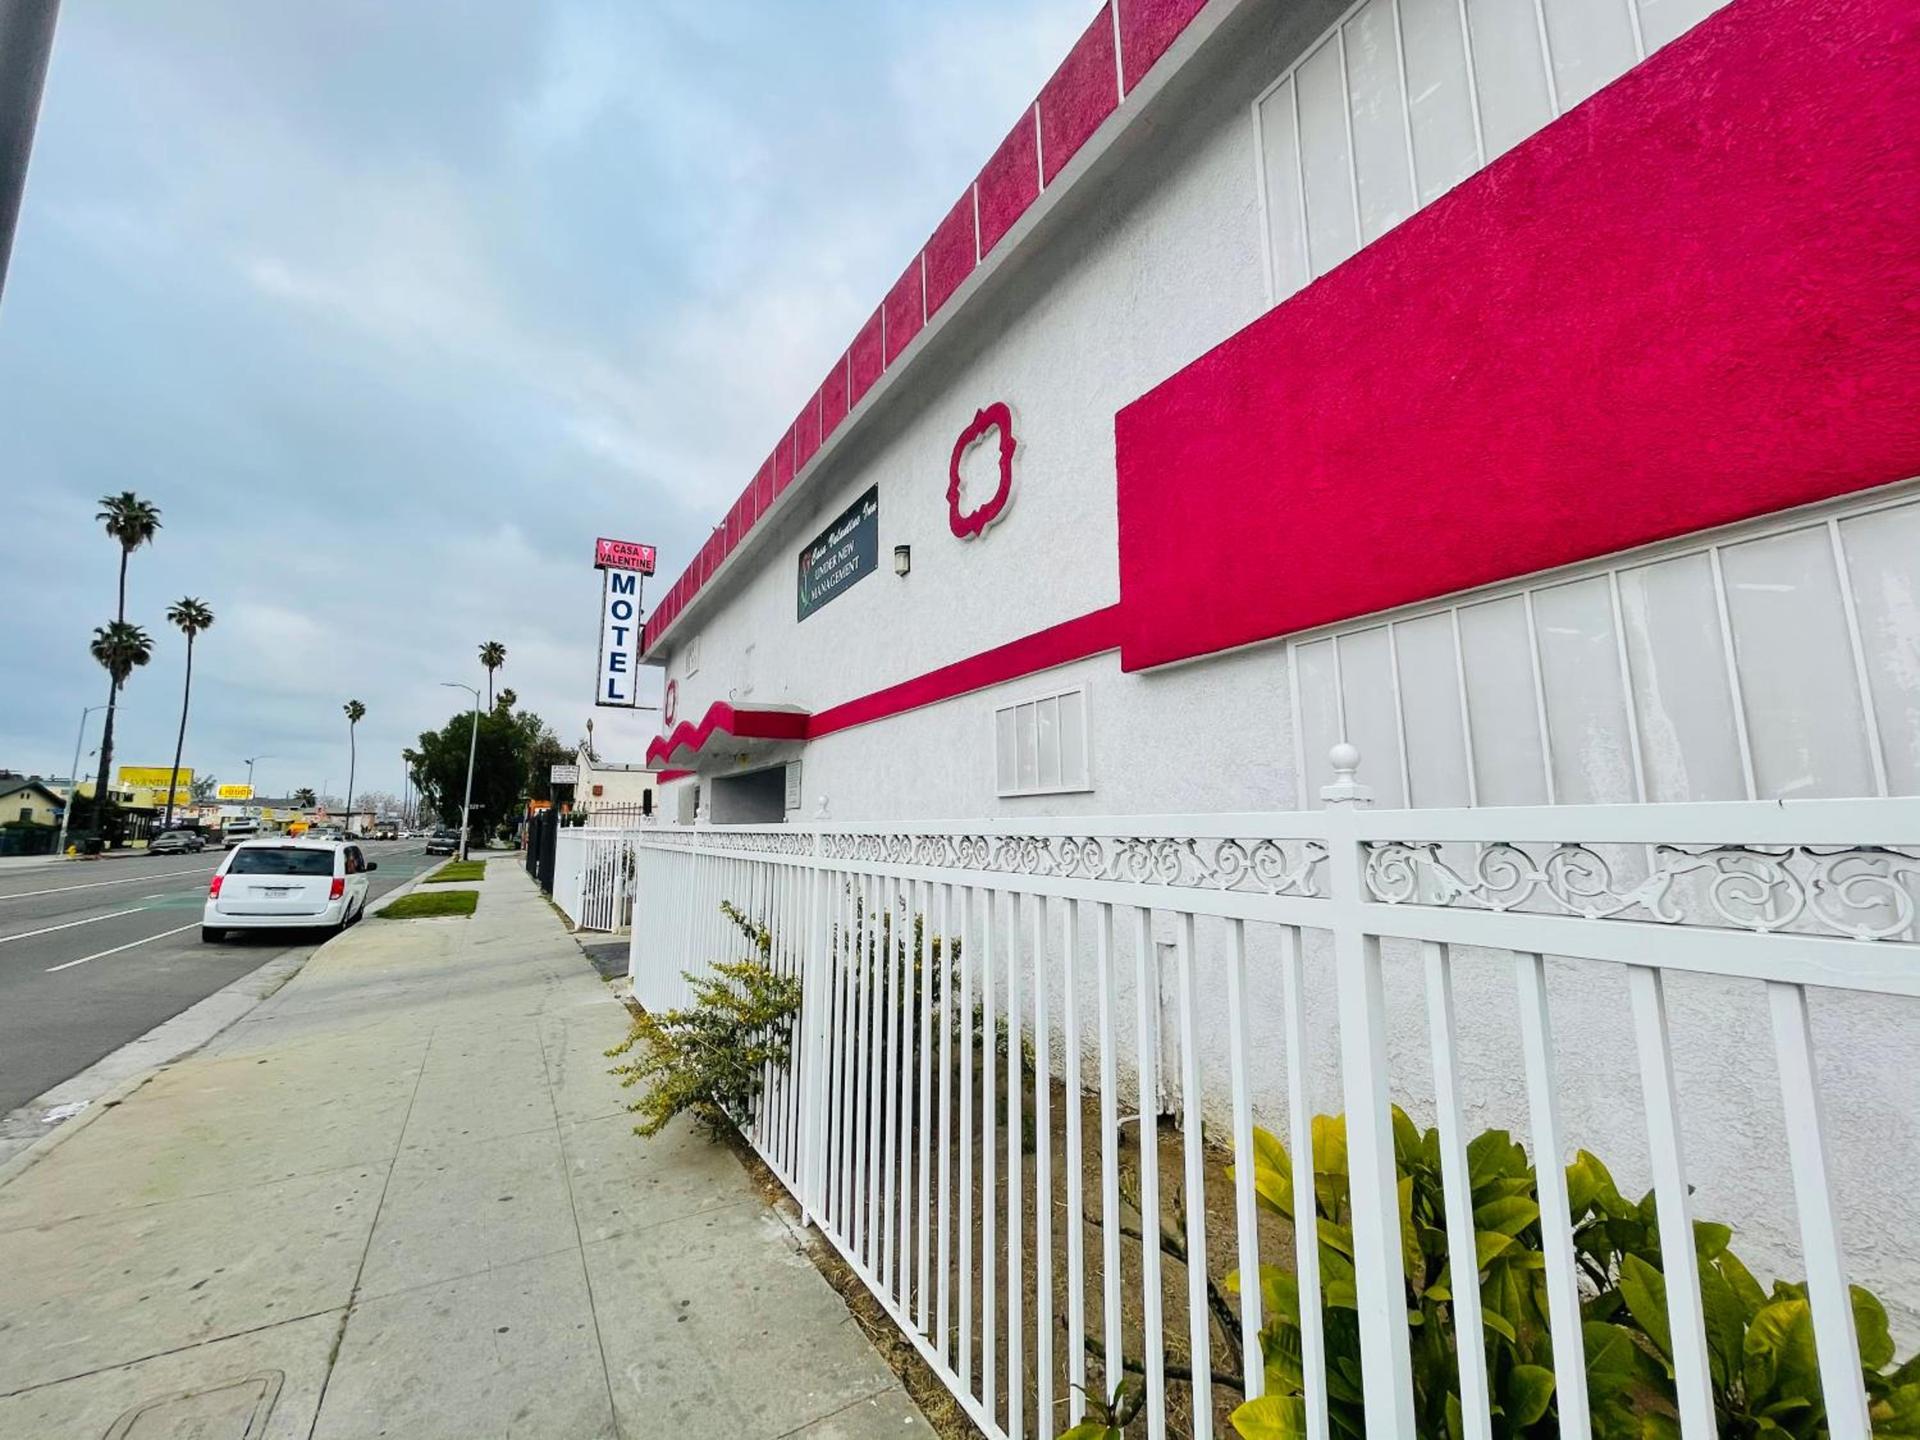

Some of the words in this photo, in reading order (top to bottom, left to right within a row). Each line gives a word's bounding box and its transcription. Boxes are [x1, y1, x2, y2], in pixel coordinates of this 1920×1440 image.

[613, 544, 640, 556] CASA
[811, 545, 827, 567] Casa
[862, 501, 878, 521] Inn
[599, 553, 652, 569] VALENTINE
[811, 555, 860, 601] MANAGEMENT
[814, 554, 838, 581] UNDER
[837, 540, 856, 563] NEW
[608, 573, 636, 699] MOTEL
